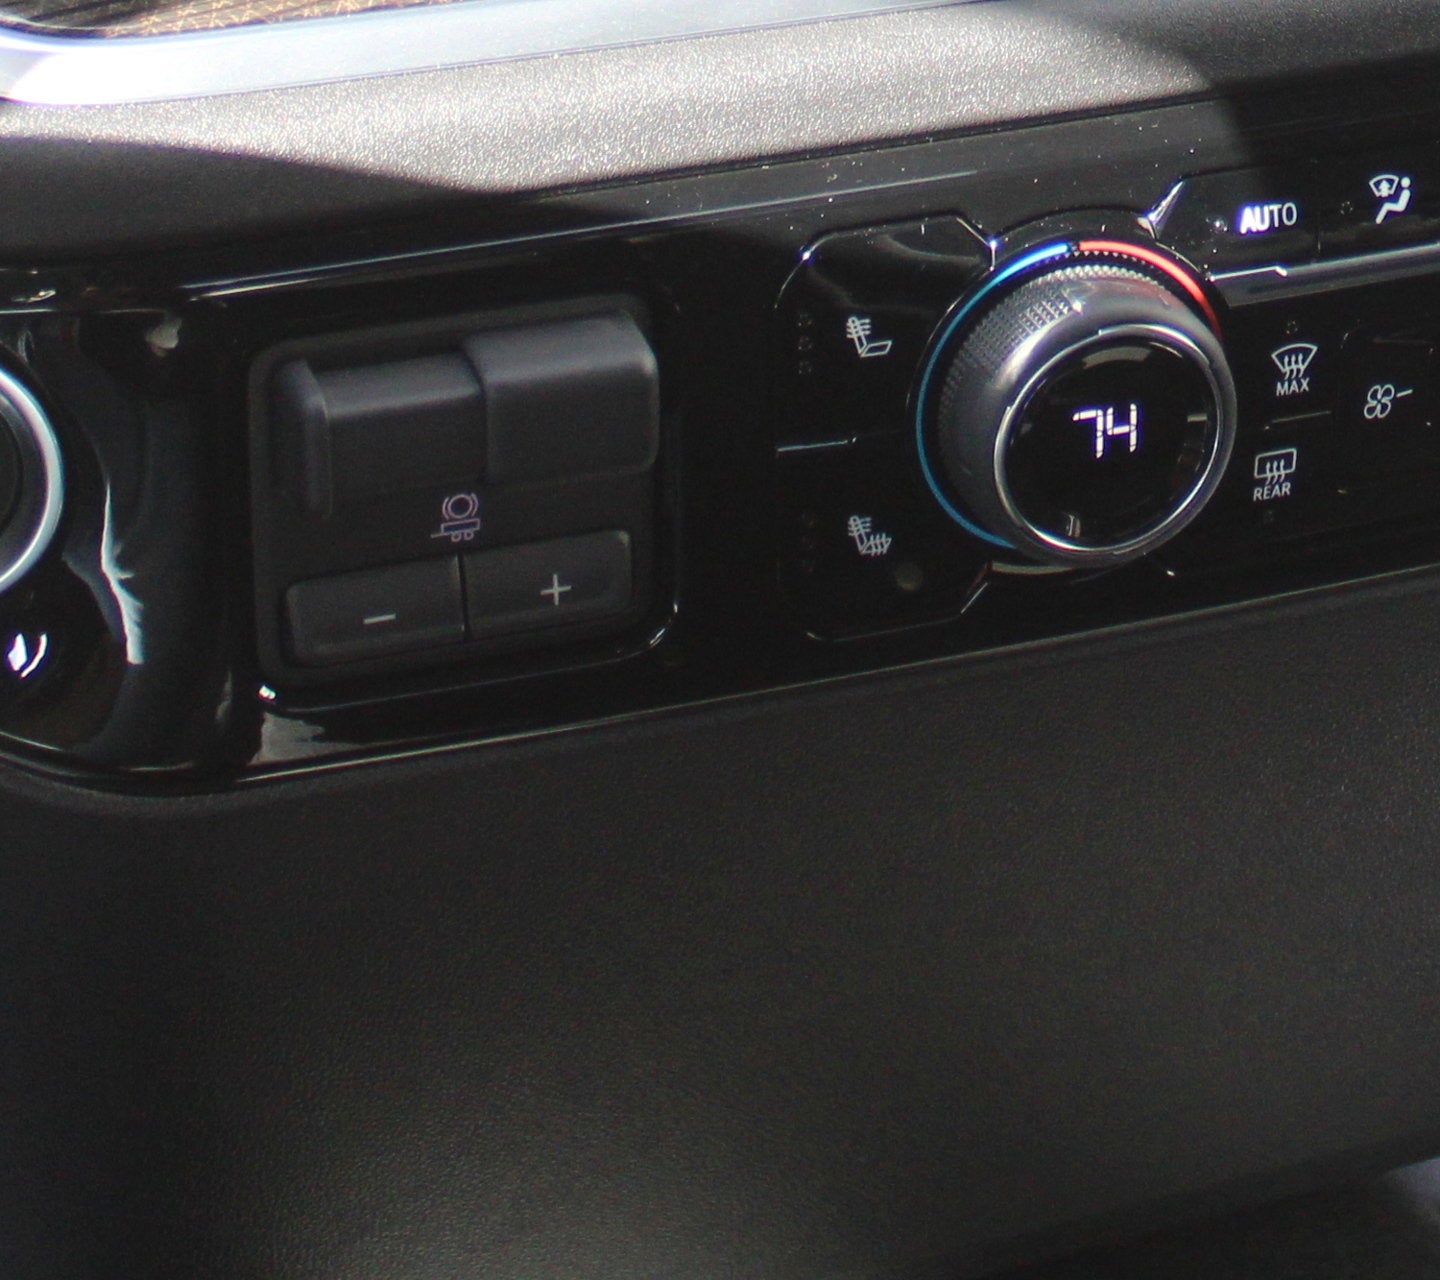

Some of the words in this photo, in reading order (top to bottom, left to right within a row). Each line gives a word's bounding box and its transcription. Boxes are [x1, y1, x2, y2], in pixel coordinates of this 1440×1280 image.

[1239, 202, 1297, 234] AUTO
[1276, 377, 1310, 397] MAX
[1072, 403, 1138, 459] 74
[1253, 482, 1292, 502] REAR
